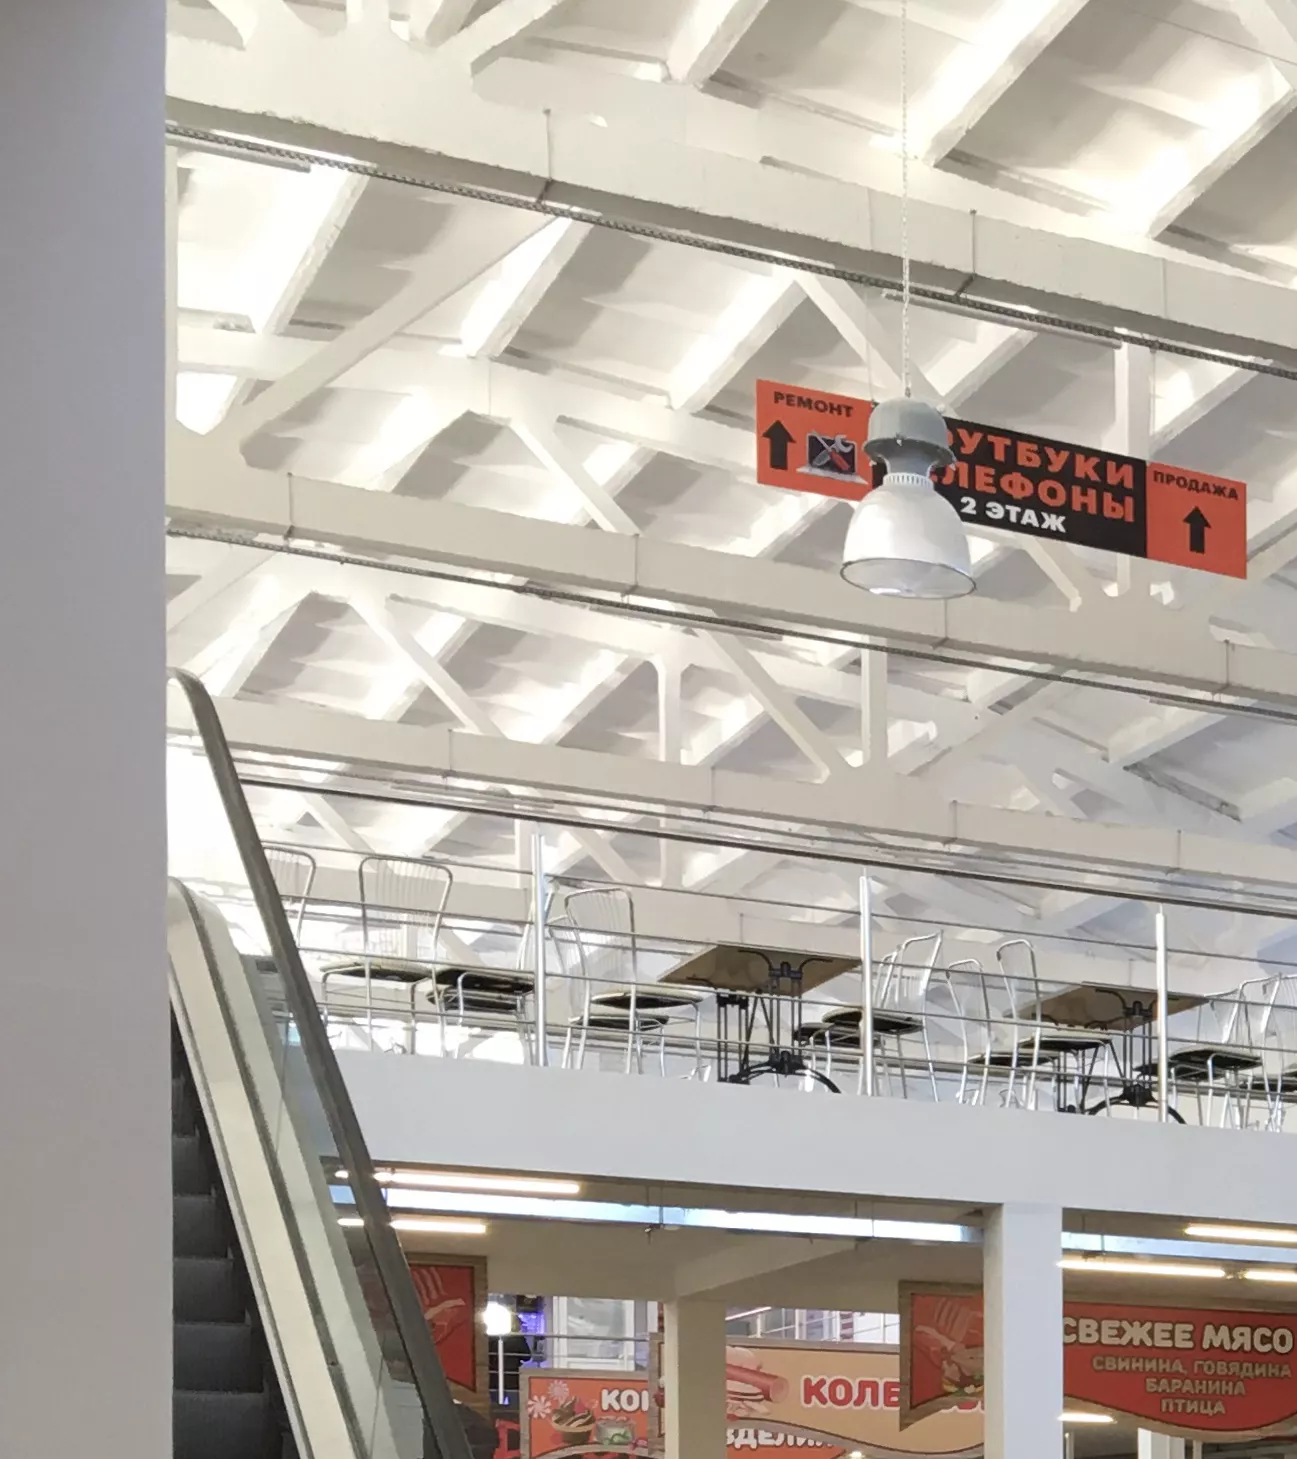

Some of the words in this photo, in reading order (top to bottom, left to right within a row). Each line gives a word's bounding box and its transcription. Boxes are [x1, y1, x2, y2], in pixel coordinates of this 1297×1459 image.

[773, 390, 853, 418] РЕМОНТ
[930, 461, 1134, 522] ЛЕФОНЫ
[1153, 470, 1238, 500] ПРОДАЖА
[960, 496, 976, 515] 2
[985, 500, 1066, 533] ЭТАЖ
[1063, 1317, 1195, 1349] СВЕЖЕЕ
[1202, 1324, 1294, 1354] МЯСО
[1093, 1355, 1187, 1375] СВИНИНА,
[1194, 1360, 1292, 1379] ГОВЯДИНА
[1146, 1378, 1246, 1396] БАРАНИНА
[1161, 1397, 1226, 1416] ПТИЦА
